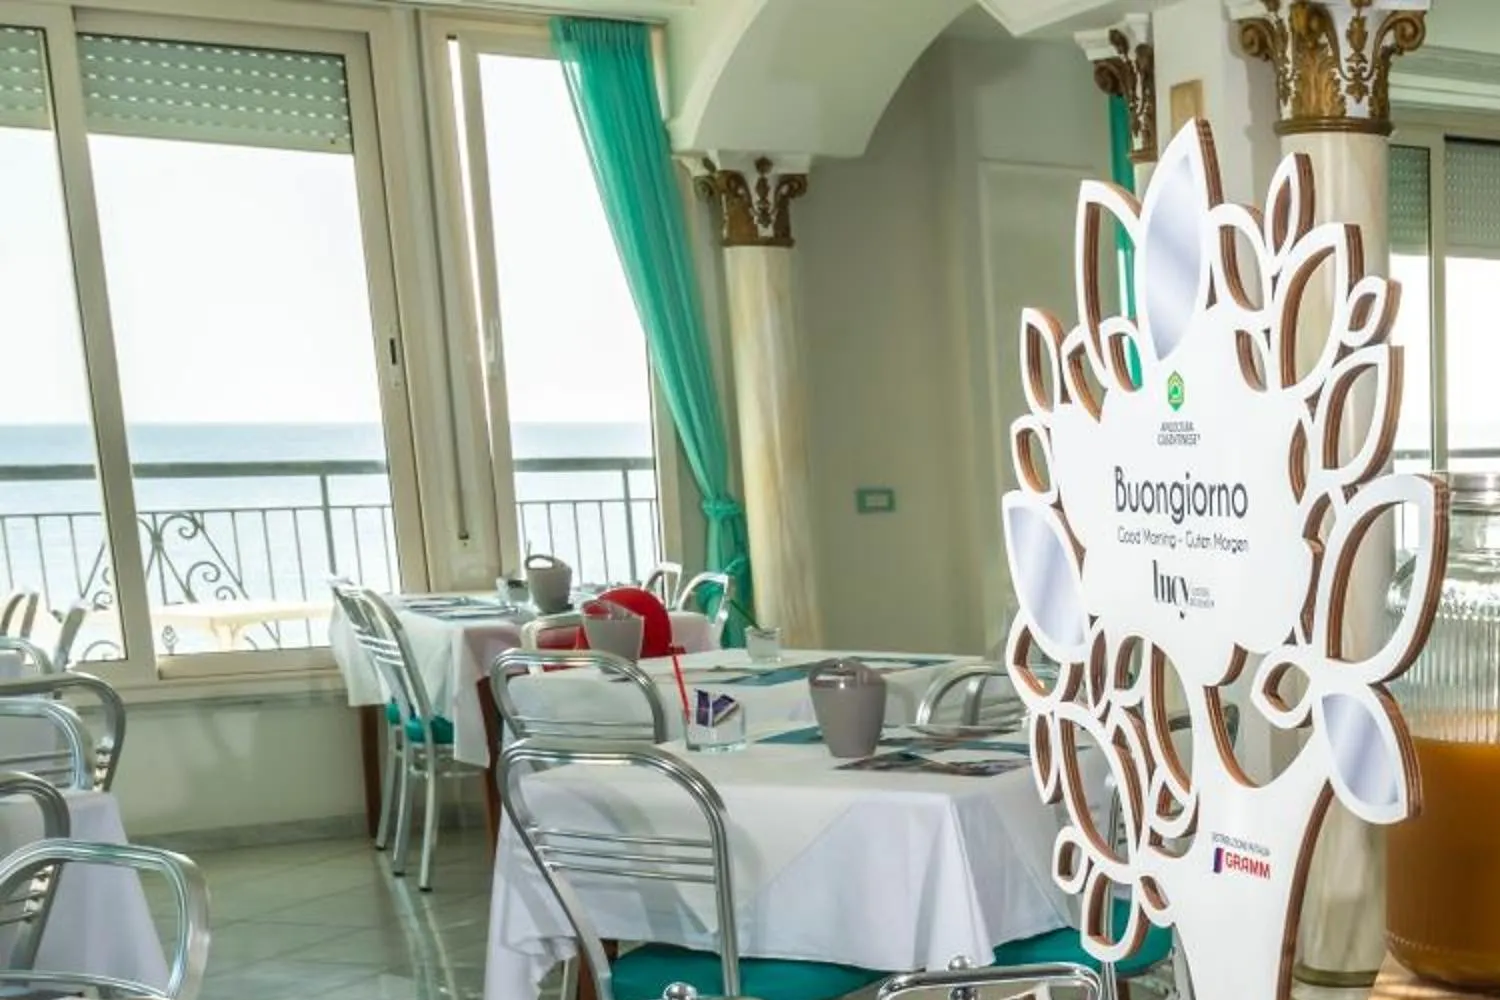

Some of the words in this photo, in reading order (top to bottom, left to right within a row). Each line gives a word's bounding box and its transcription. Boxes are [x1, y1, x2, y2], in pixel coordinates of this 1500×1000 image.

[1114, 465, 1248, 524] Buongiorno
[1117, 526, 1141, 545] Good
[1143, 528, 1177, 550] Morning
[1185, 530, 1211, 549] Guten
[1213, 533, 1249, 554] Morgen
[1225, 851, 1271, 880] GRAMM
